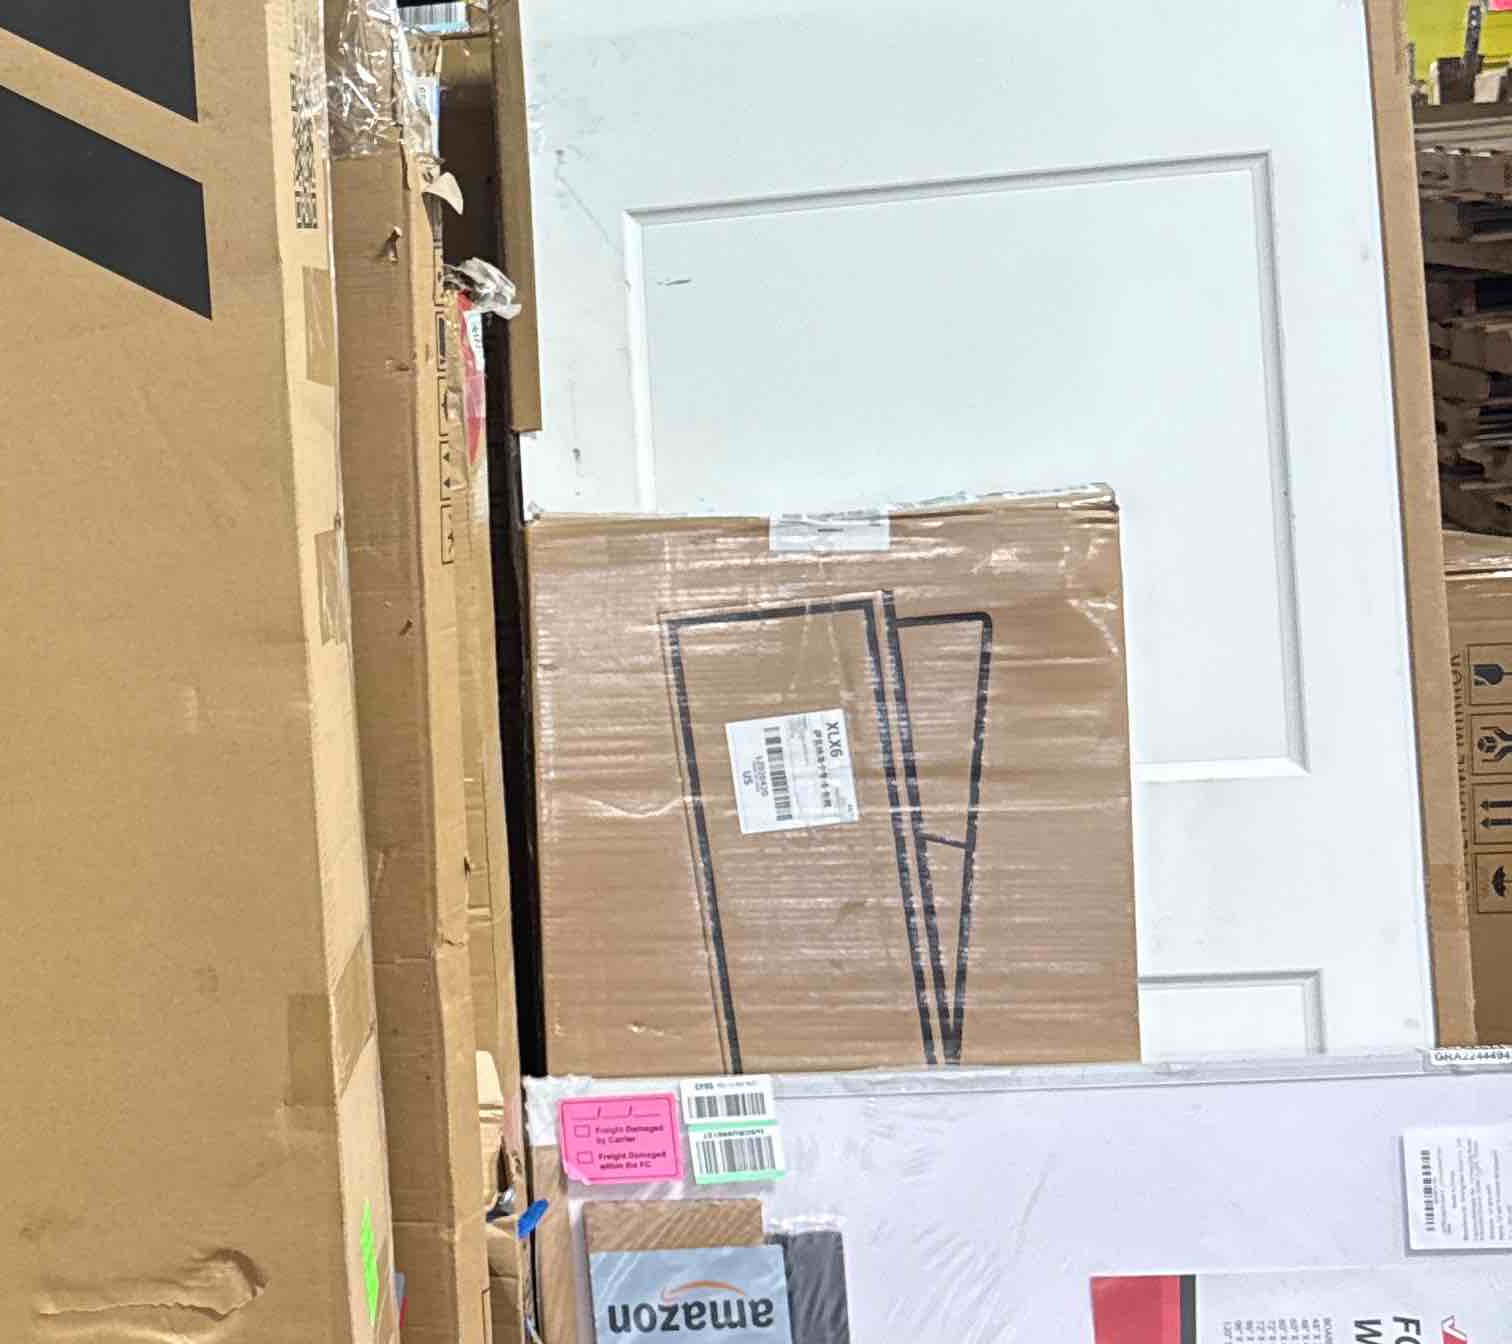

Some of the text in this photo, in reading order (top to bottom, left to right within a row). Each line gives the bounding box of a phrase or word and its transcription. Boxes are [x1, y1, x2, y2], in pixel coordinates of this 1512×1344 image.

[825, 721, 842, 758] XLX6
[743, 770, 754, 786] US
[625, 1124, 664, 1133] Damaged
[607, 1135, 636, 1144] Carrier
[628, 1151, 667, 1160] Damaged
[608, 1298, 774, 1333] amazon
